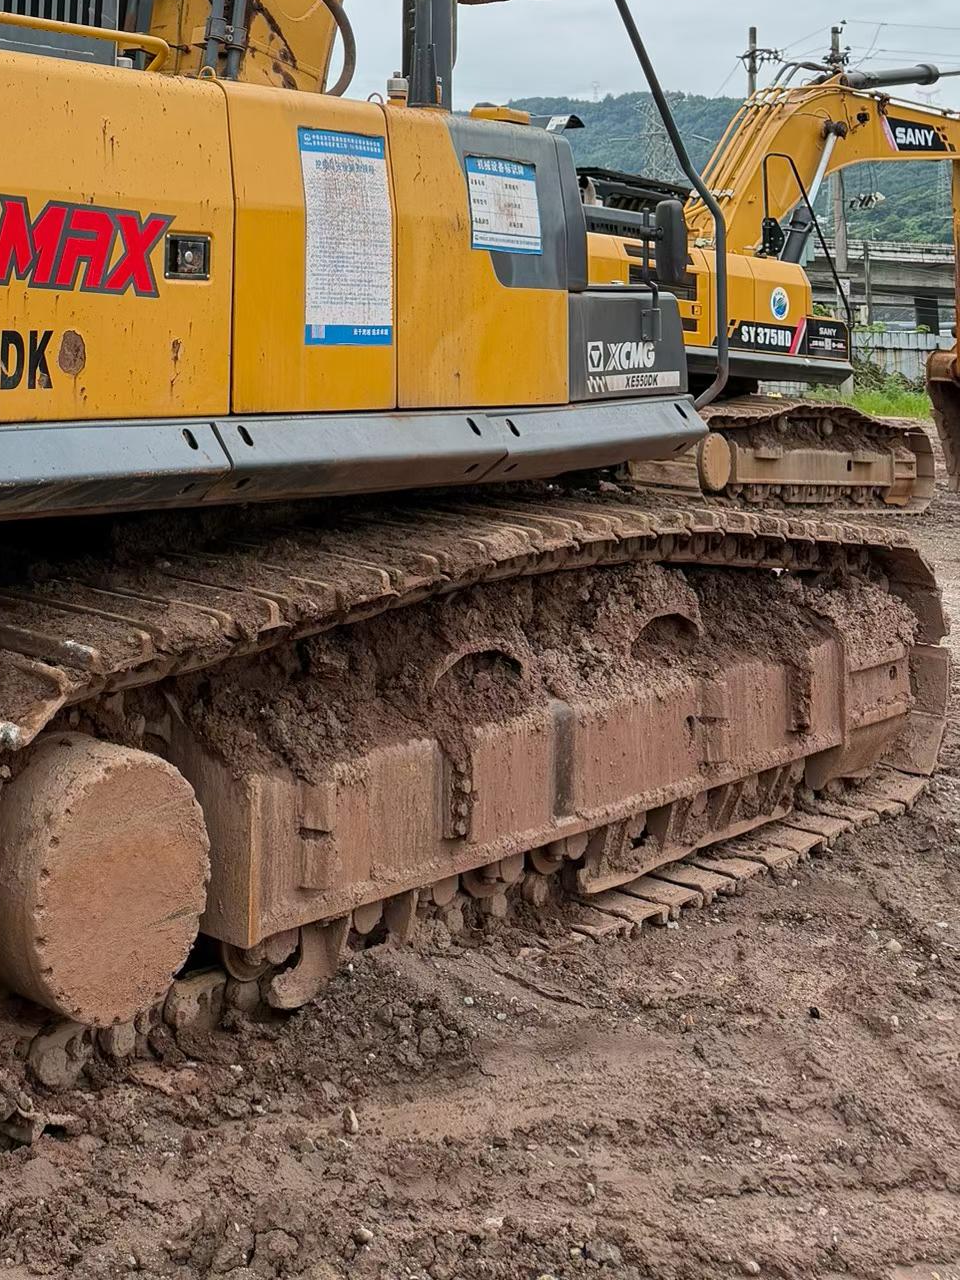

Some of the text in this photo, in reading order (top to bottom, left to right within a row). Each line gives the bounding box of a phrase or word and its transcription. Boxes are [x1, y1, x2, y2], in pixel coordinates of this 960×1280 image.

[895, 126, 935, 147] SANY
[818, 327, 837, 336] SANY
[605, 341, 656, 372] XCMG
[624, 374, 659, 389] XE550DK
